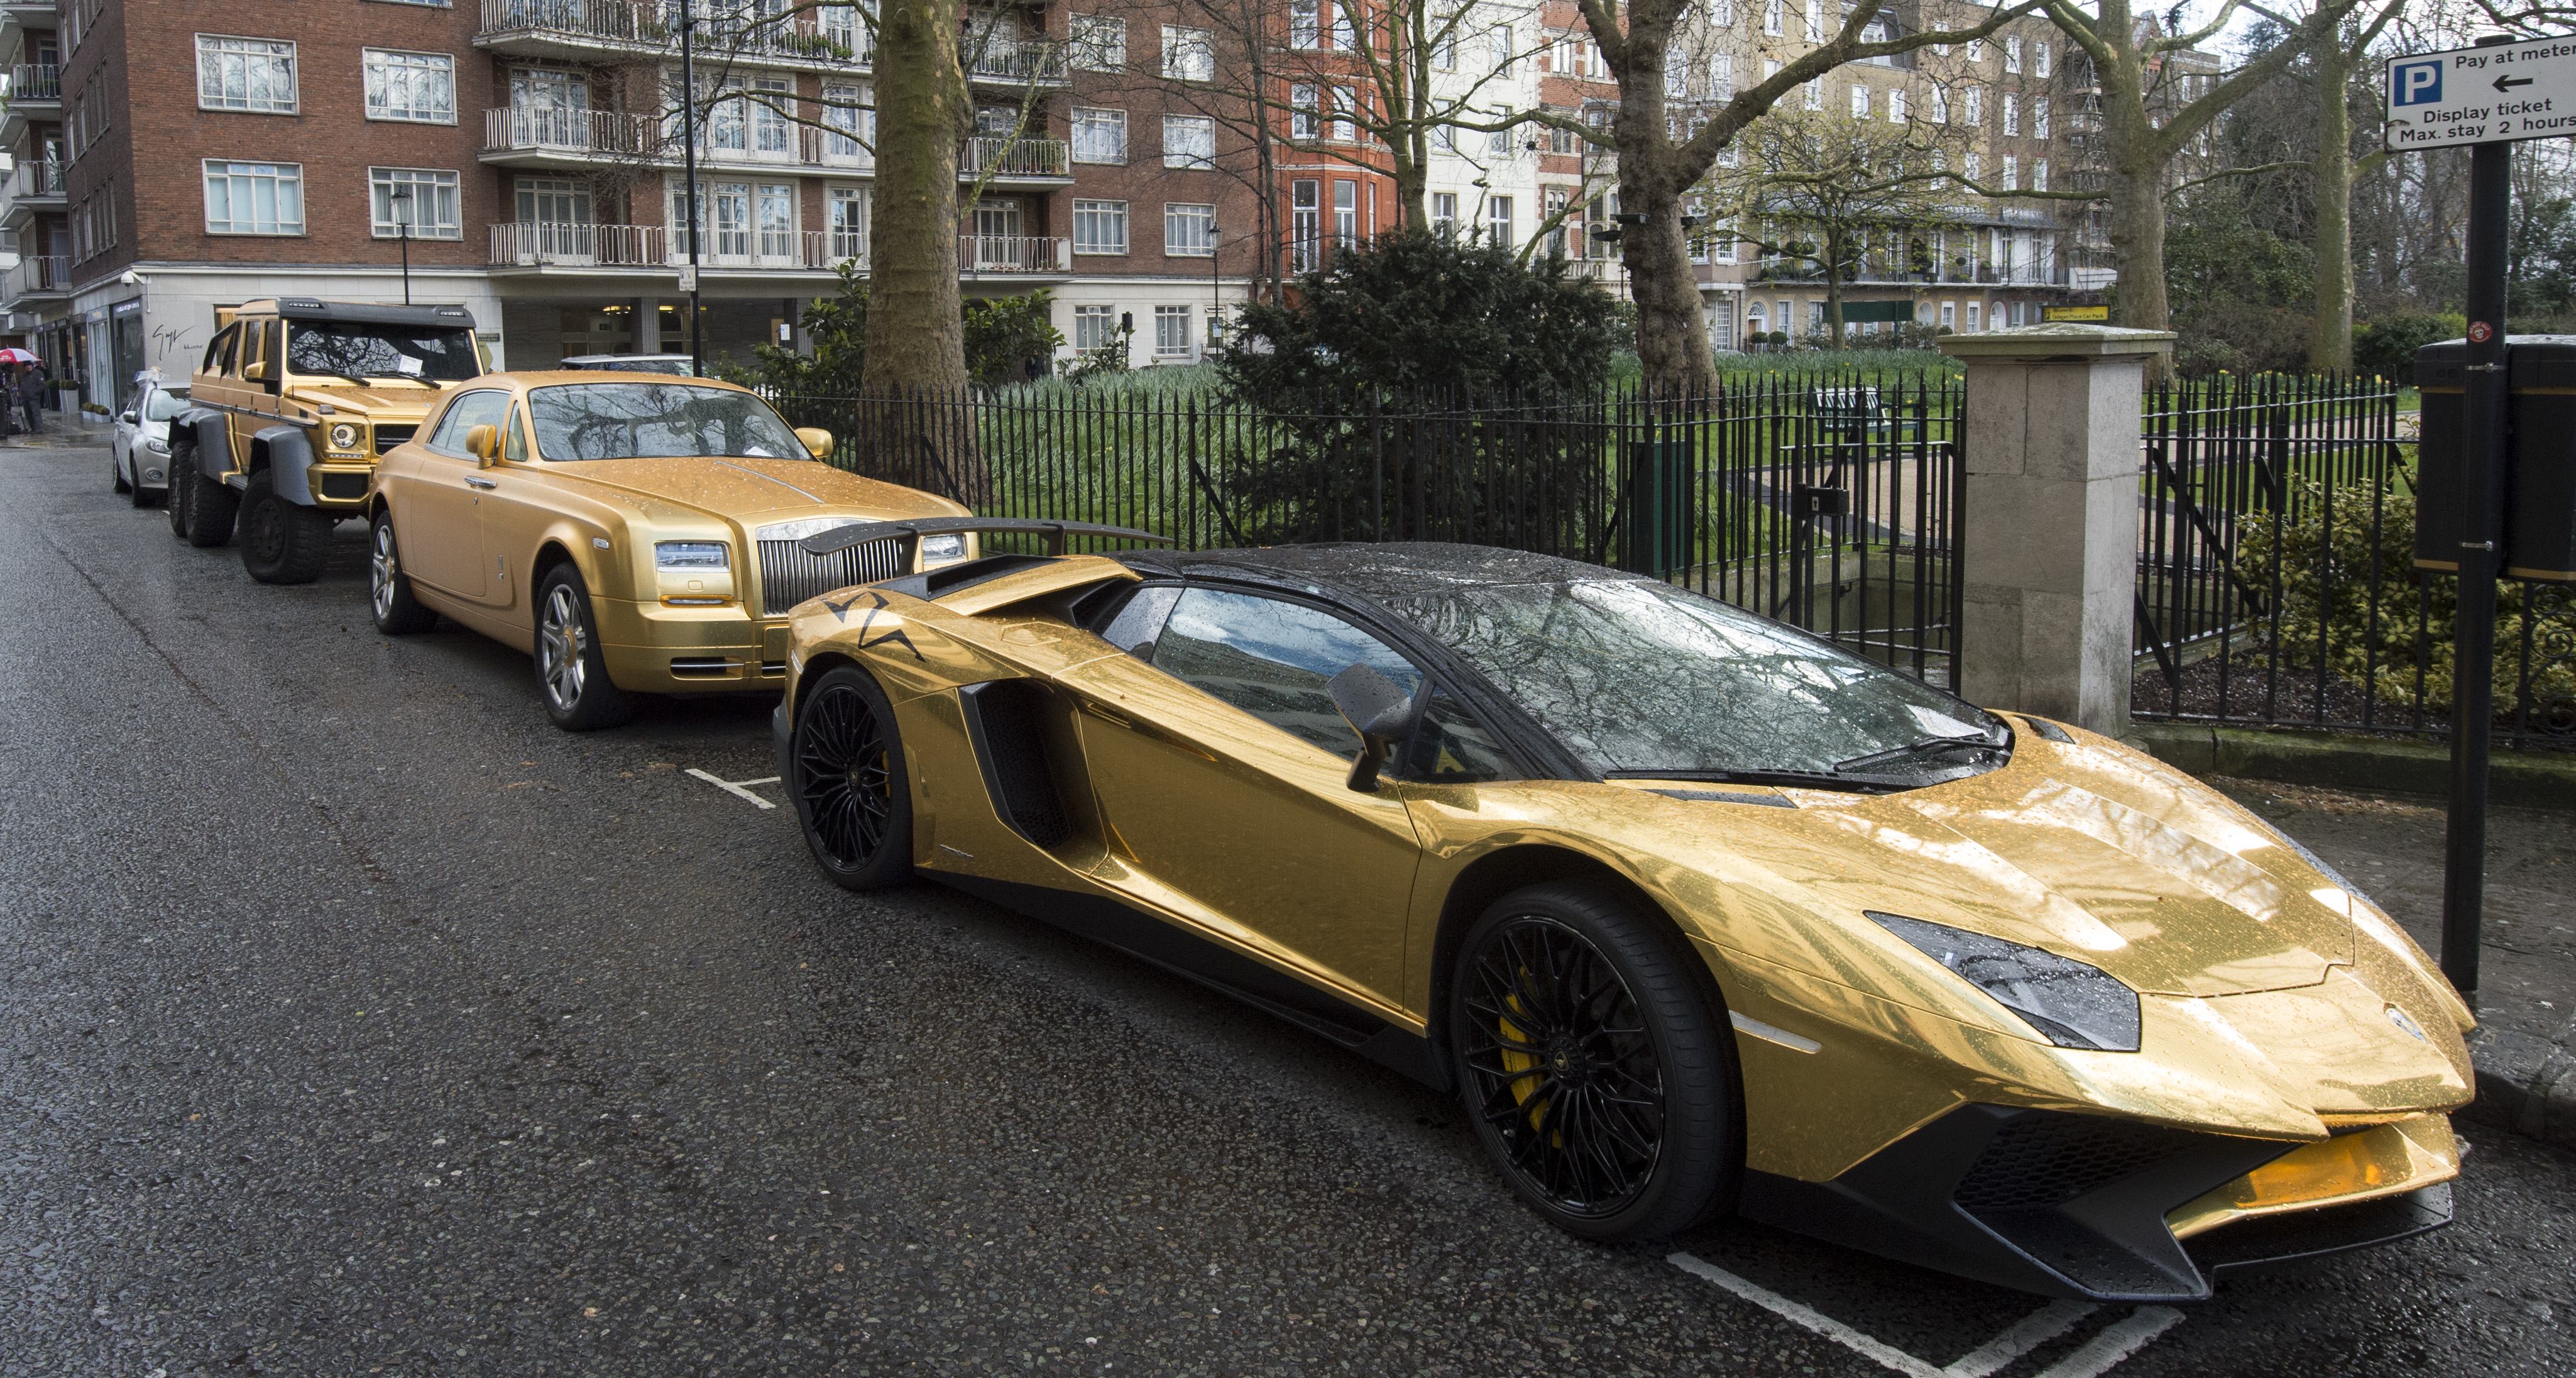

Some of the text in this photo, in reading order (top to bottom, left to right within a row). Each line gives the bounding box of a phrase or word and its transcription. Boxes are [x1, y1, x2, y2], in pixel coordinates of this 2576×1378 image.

[2455, 43, 2576, 69] Pay at meter
[2405, 65, 2436, 103] P
[2423, 97, 2552, 124] Display ticket
[2400, 116, 2576, 143] Max. stay 2 hours
